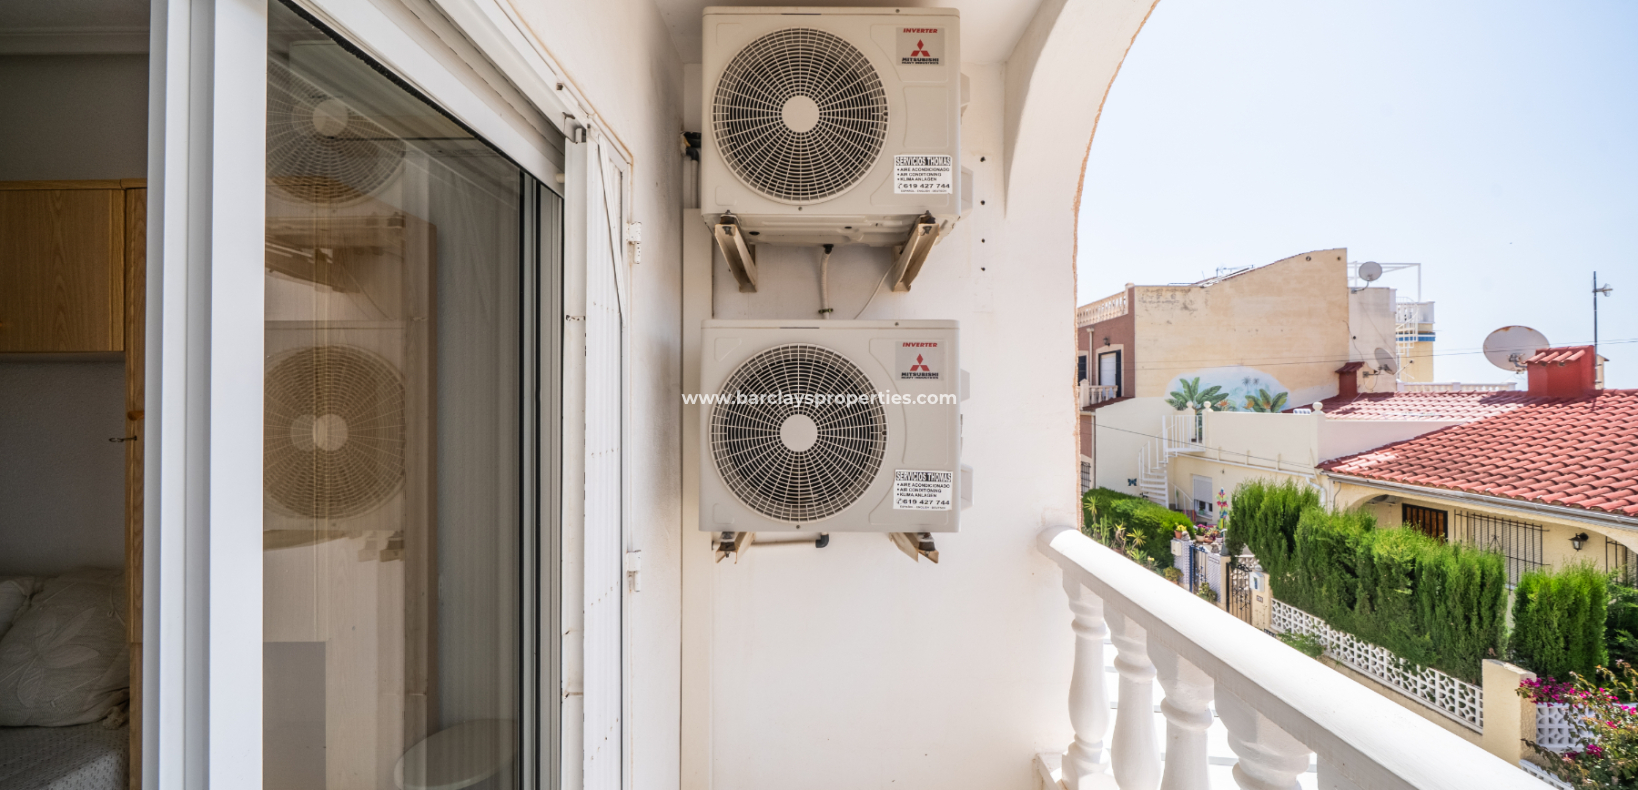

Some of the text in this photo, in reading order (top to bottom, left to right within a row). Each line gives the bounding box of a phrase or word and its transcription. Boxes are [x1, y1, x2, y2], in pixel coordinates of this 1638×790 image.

[896, 156, 950, 166] SERVICIOS THOMAS
[896, 471, 951, 482] SERVICIOS THOMAS
